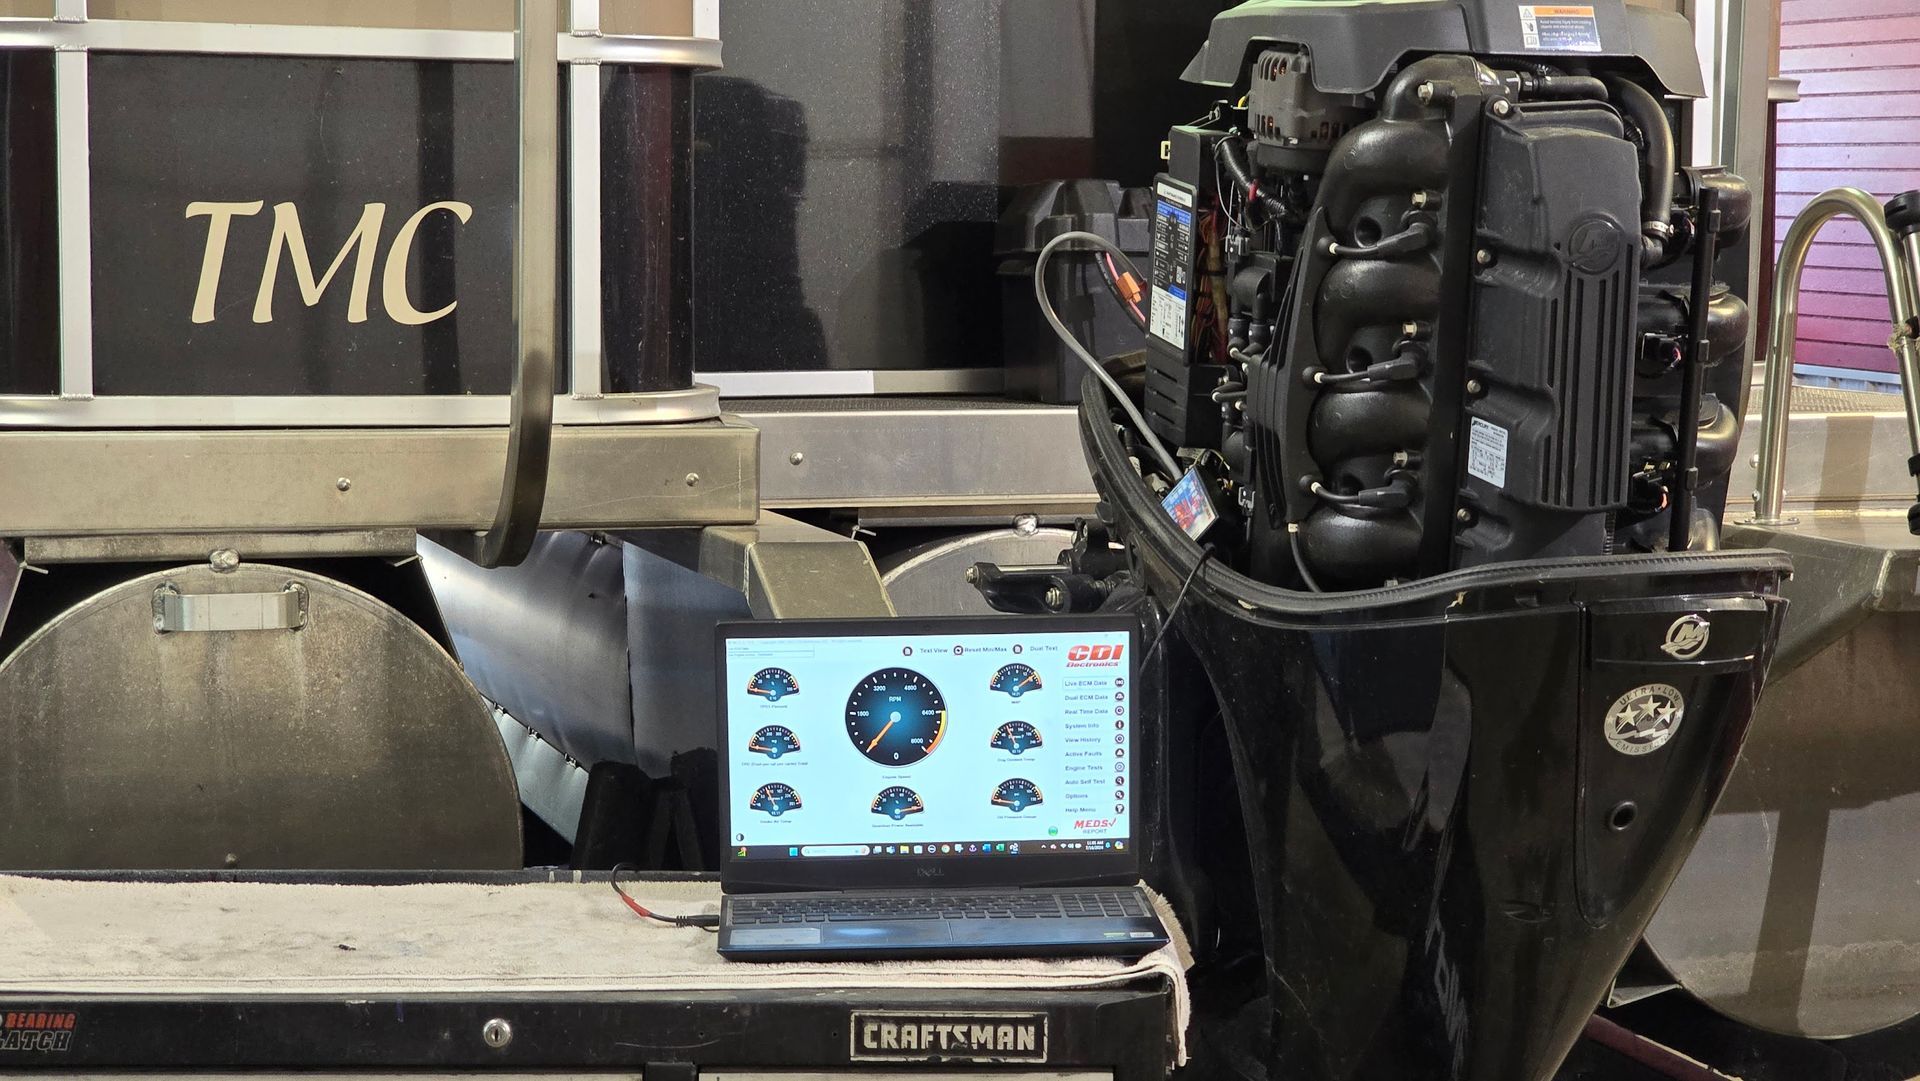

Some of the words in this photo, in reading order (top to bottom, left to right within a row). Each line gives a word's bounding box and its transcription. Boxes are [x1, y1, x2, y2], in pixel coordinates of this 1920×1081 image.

[185, 199, 473, 325] TMC
[1067, 644, 1124, 661] CDI
[1662, 687, 1681, 701] LOW
[893, 752, 899, 760] 0
[1074, 819, 1108, 829] MEDS
[5, 1012, 76, 1029] BEARING
[863, 1023, 1035, 1051] CRAFTSMAN
